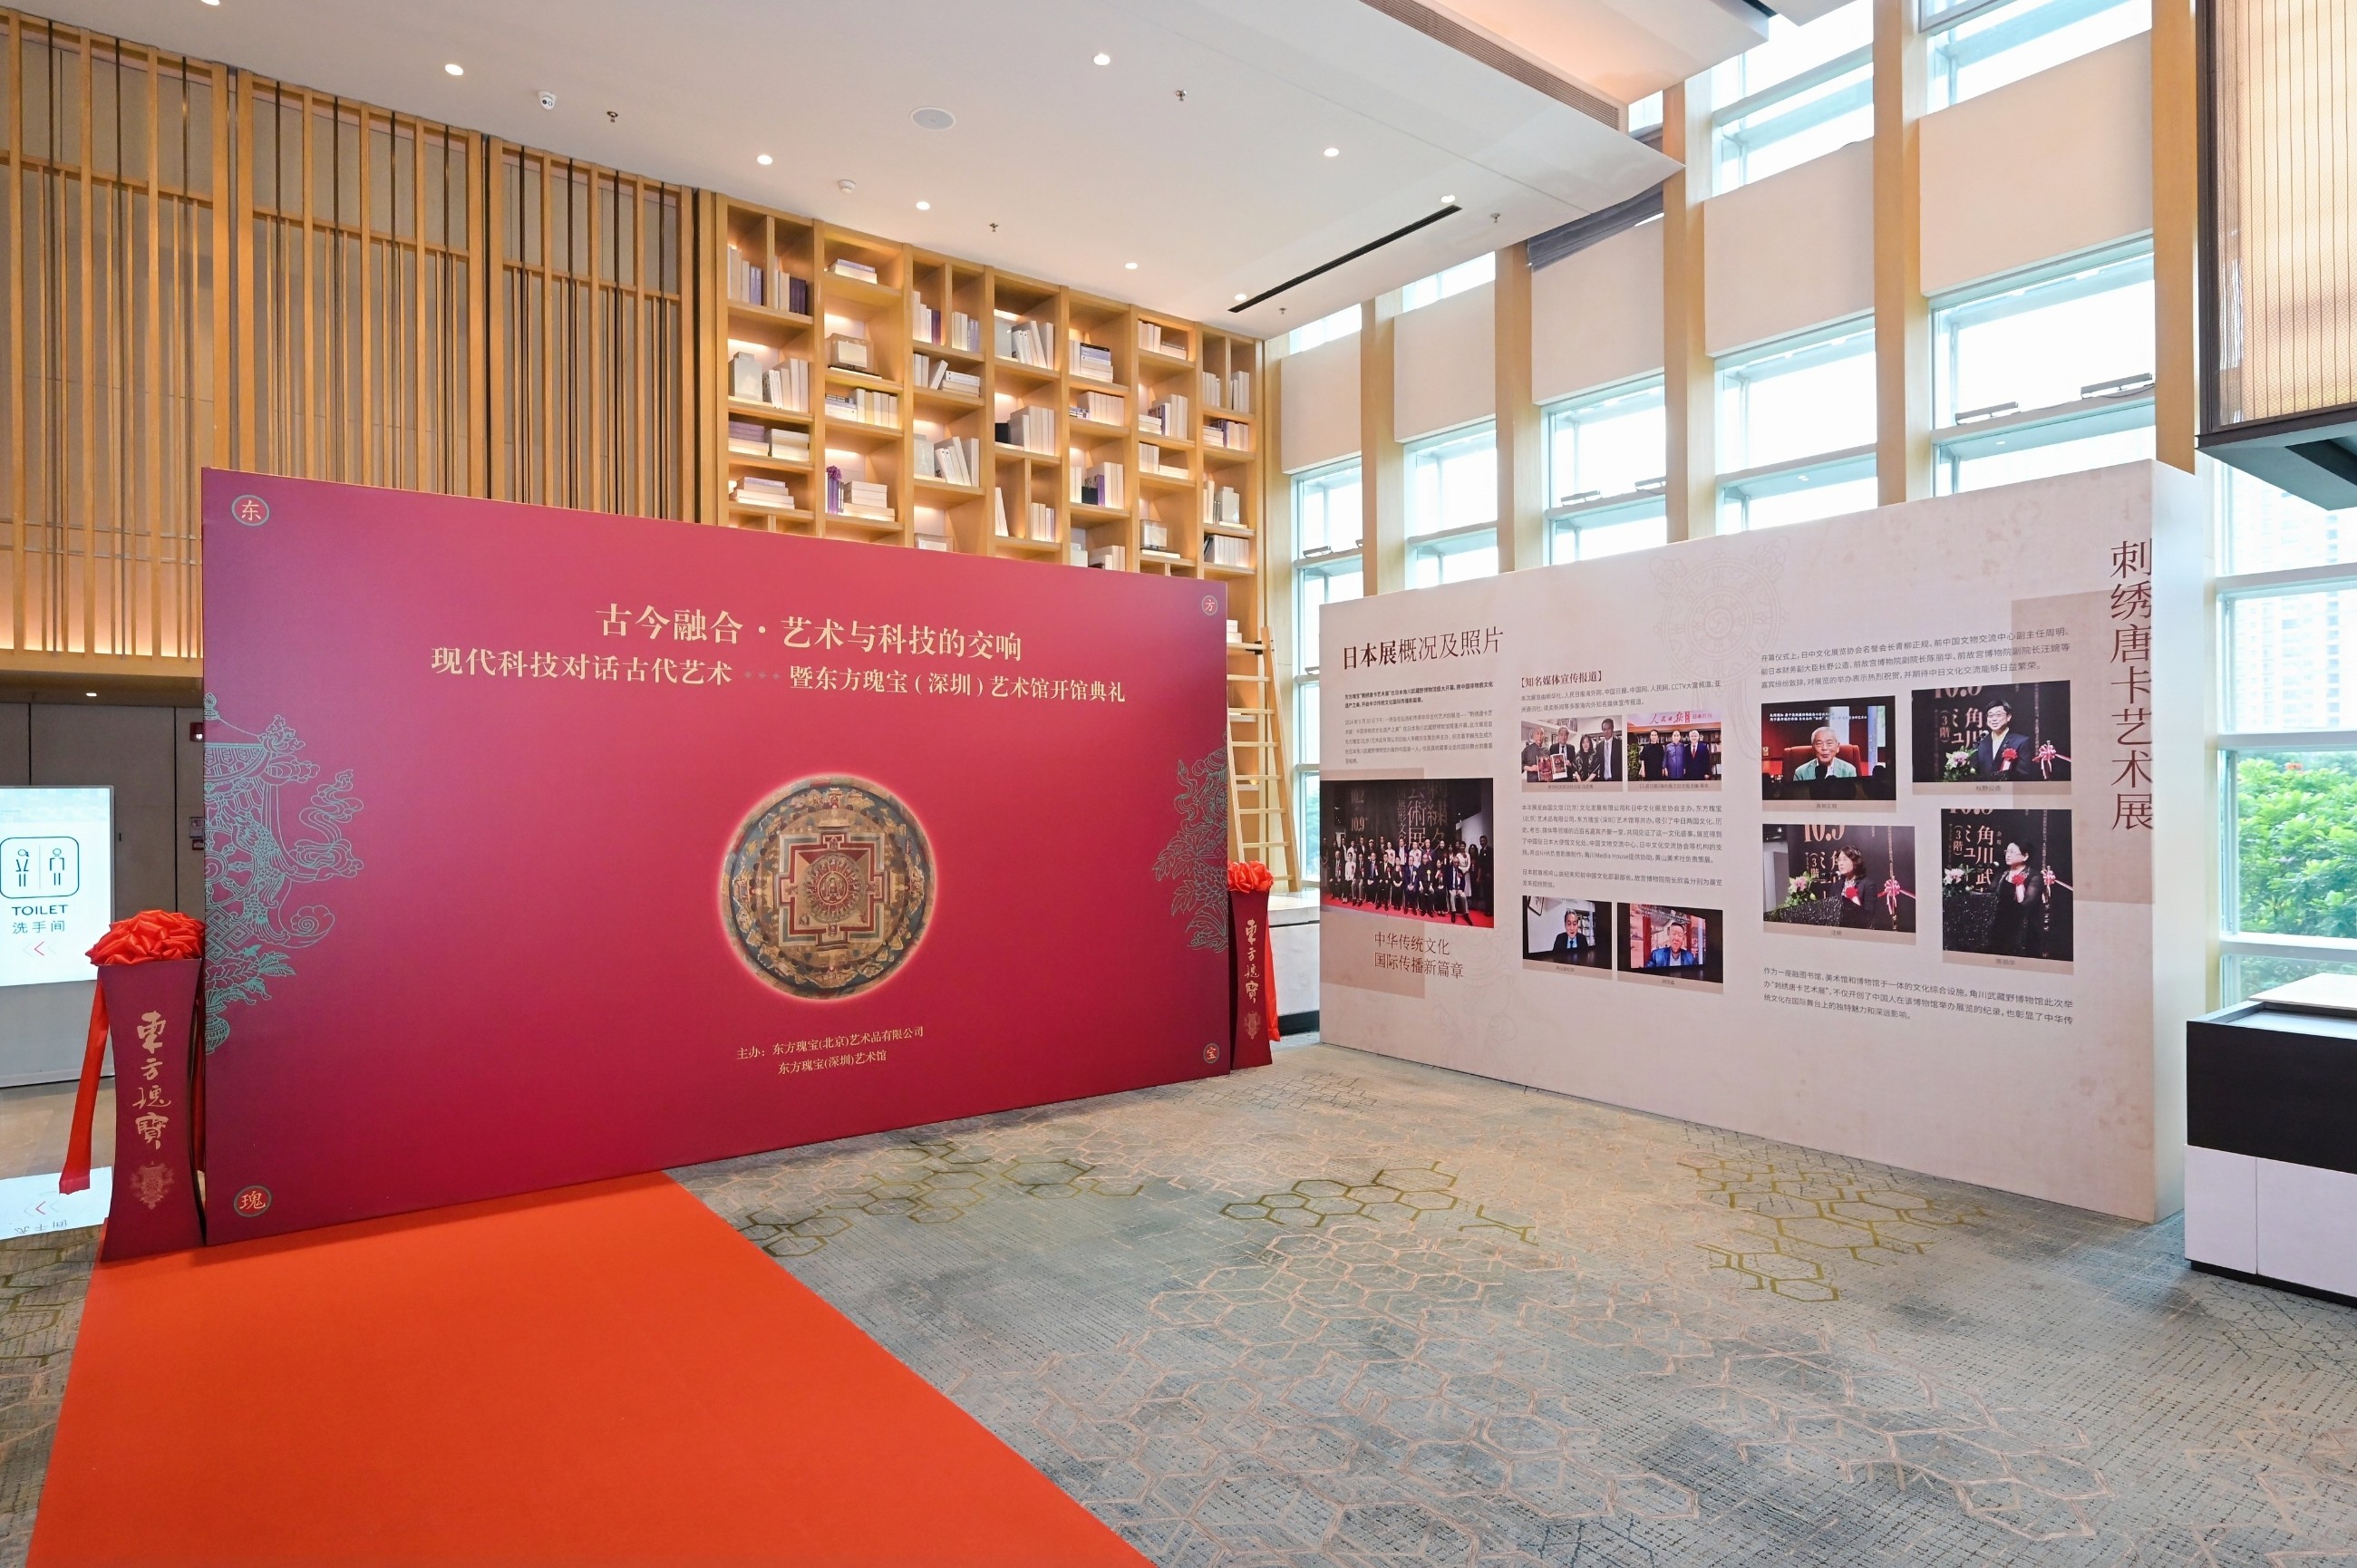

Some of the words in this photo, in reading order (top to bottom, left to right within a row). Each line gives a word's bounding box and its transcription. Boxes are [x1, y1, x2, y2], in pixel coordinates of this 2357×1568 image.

[241, 499, 262, 521] 东
[1205, 598, 1216, 612] 方
[1343, 626, 1504, 671] 日本展概况及照片
[430, 646, 732, 686] 现代科技对话古代艺术
[1520, 670, 1603, 688] 【知名媒体宣传报道】
[2110, 537, 2154, 830] 刺绣唐卡艺术展
[11, 904, 69, 916] TOILET
[12, 920, 65, 934] 洗手间
[1374, 931, 1450, 955] 中华传统文化
[1374, 952, 1464, 979] 国际传播新篇章
[1207, 1046, 1217, 1060] 宝
[238, 1192, 266, 1211] 瑰
